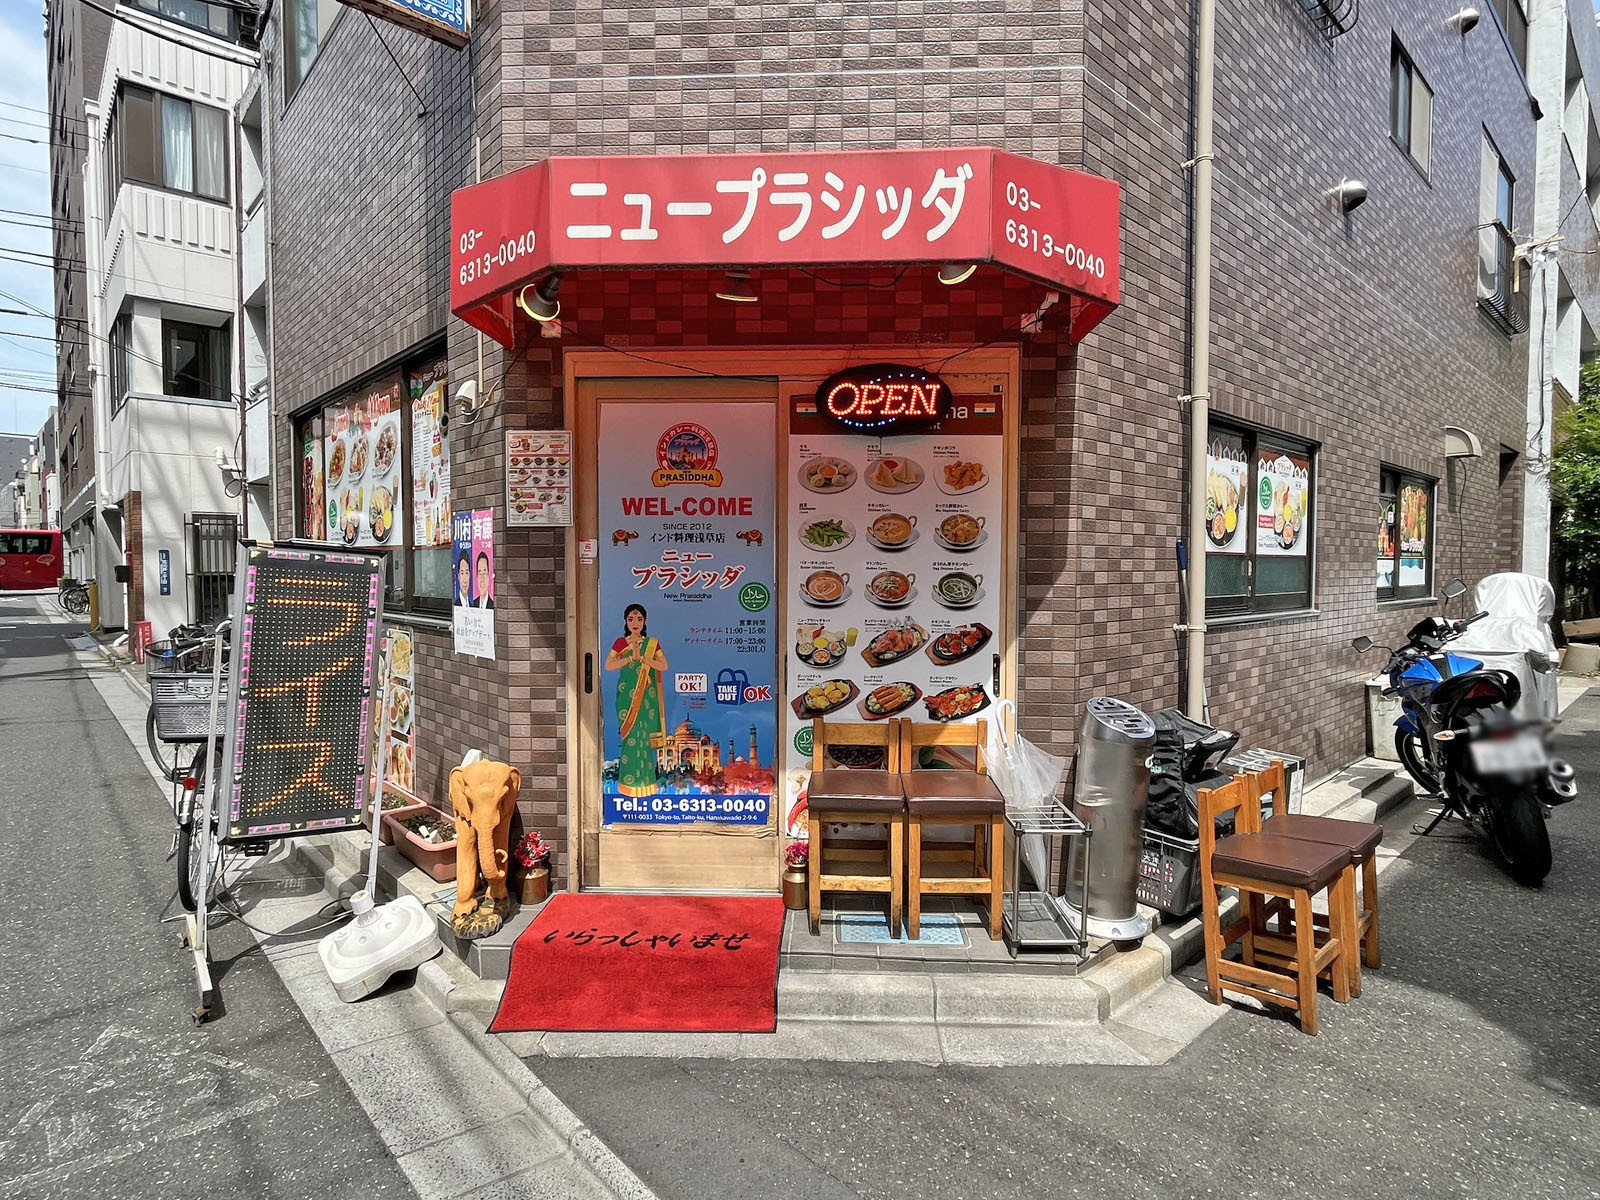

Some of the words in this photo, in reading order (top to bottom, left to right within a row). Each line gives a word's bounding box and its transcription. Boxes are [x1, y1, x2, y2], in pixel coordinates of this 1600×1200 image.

[566, 162, 973, 244] ニュープラシッダ
[1006, 181, 1041, 212] 03-
[460, 228, 483, 254] 03-
[1005, 218, 1105, 279] 6313-0040
[460, 229, 536, 286] 6313-0040
[827, 382, 941, 416] OPEN
[659, 473, 715, 481] PRASIDDHA
[621, 497, 753, 516] WEL-COME
[454, 517, 472, 541] 川村
[662, 549, 714, 563] ニュー
[632, 565, 746, 589] プラシッダ
[679, 682, 702, 691] OK!
[717, 685, 737, 693] TAKE
[717, 693, 738, 701] OUT
[744, 685, 772, 702] OK
[613, 797, 648, 812] Tel.:
[651, 798, 766, 812] 03-6313-0040
[543, 928, 751, 950] いらっしゃいませ
